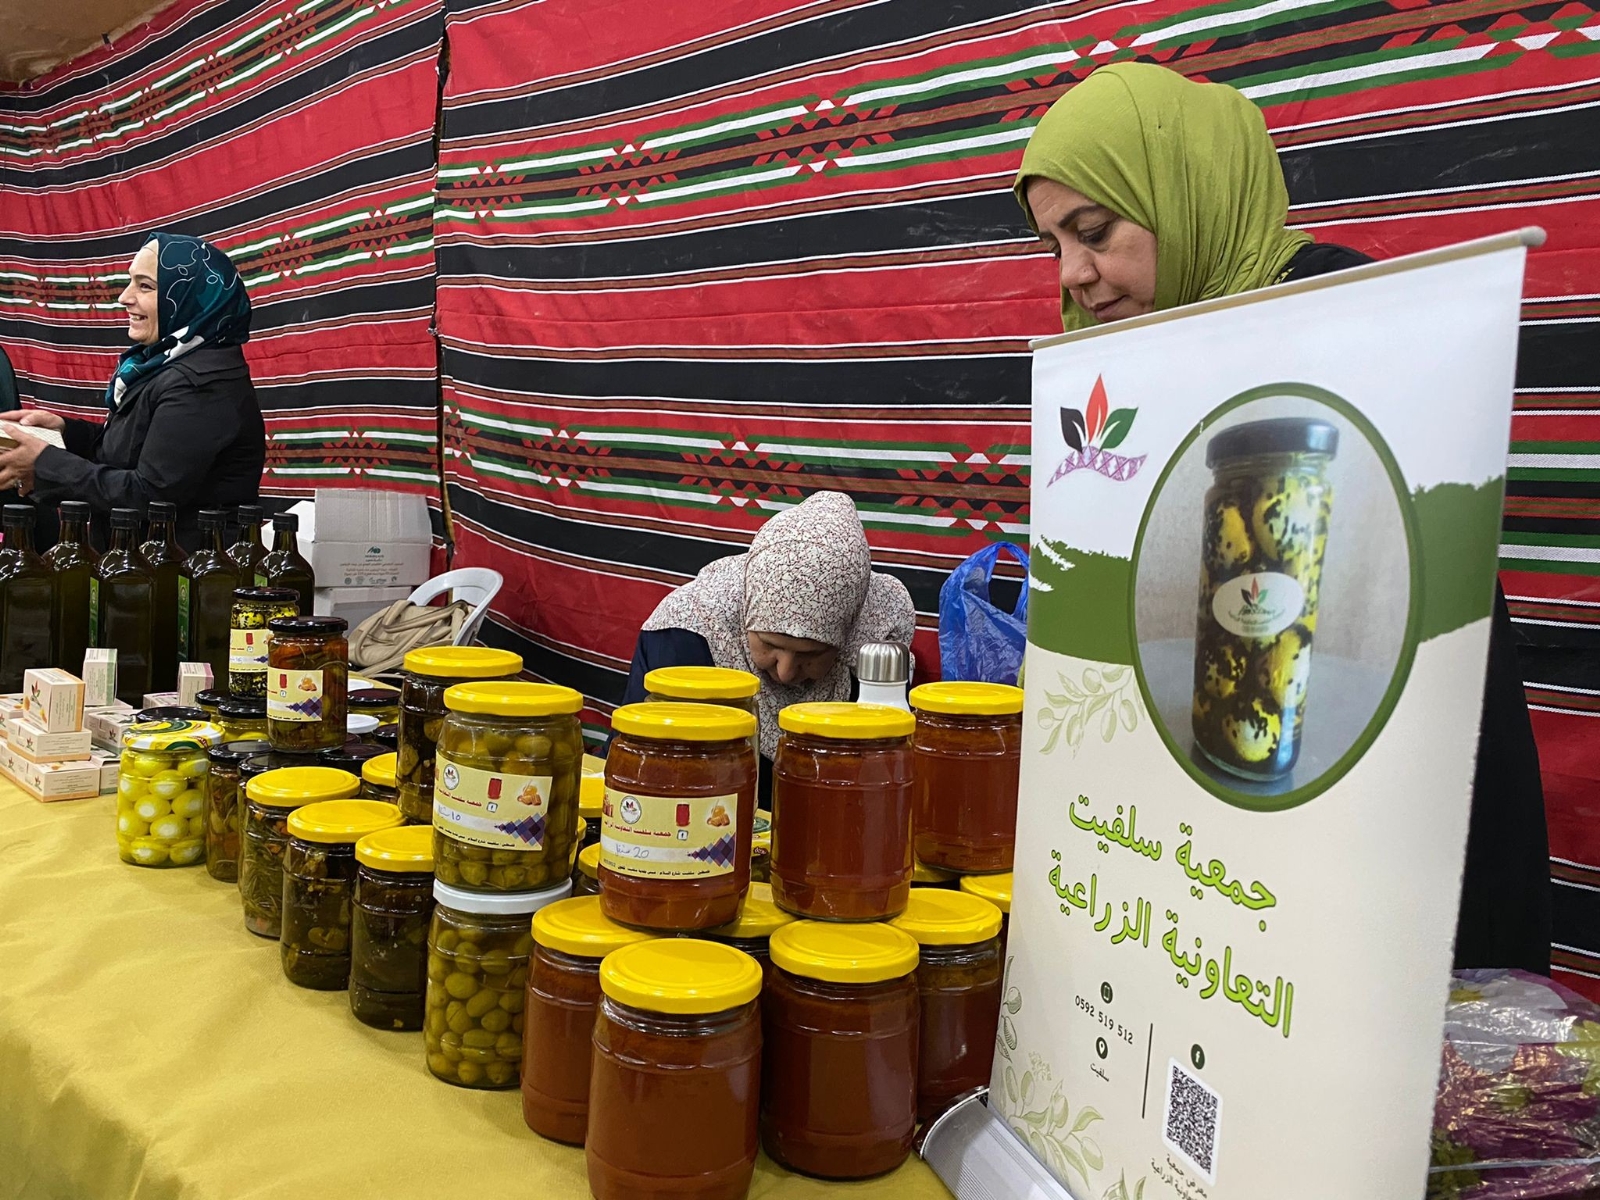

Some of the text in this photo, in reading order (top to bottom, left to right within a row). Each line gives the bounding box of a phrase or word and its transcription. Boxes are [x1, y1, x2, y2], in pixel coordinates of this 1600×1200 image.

[633, 846, 650, 858] 20
[1069, 794, 1276, 932] جمعية سلفيت
[1048, 849, 1293, 1038] التعاونية الزراعية
[1075, 995, 1133, 1045] 0592 519 512
[1090, 1063, 1110, 1082] سلفيت
[1166, 1153, 1208, 1199] معرض جمعية
